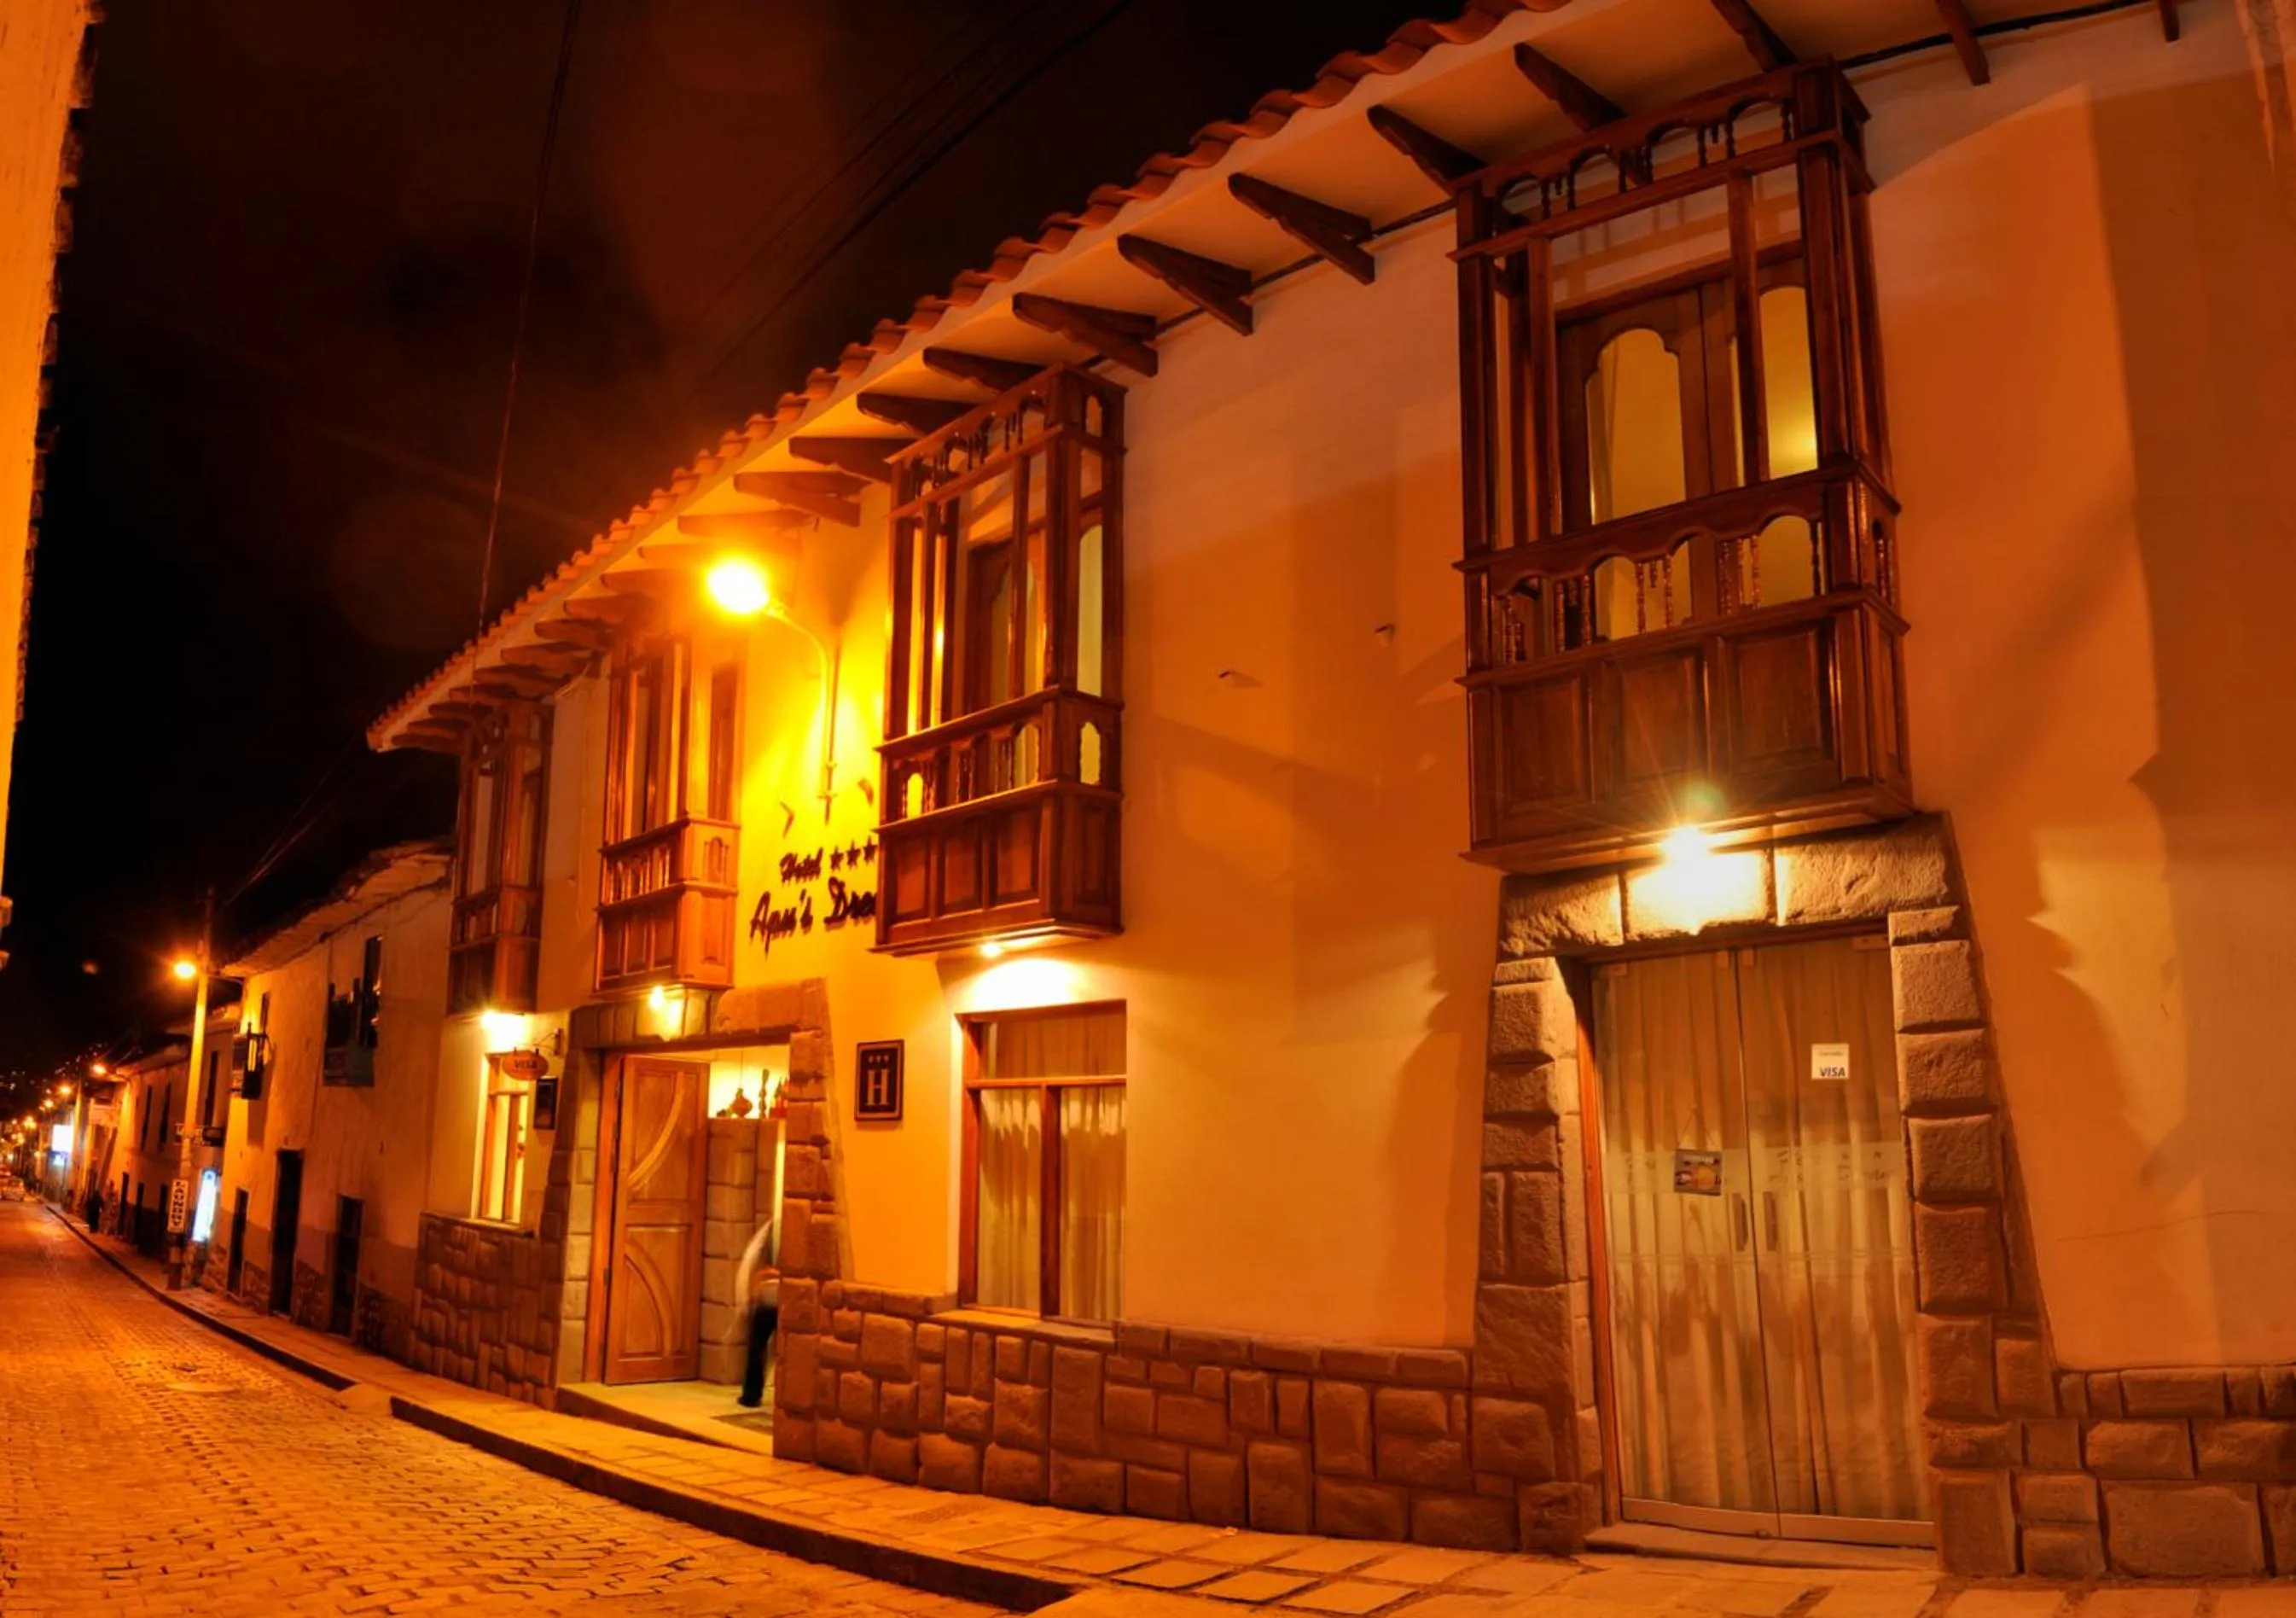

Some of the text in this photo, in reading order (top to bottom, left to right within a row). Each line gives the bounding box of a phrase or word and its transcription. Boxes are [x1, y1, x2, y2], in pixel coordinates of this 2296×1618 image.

[780, 847, 822, 882] Hotel
[865, 1068, 889, 1106] H
[1819, 1067, 1846, 1076] VISA
